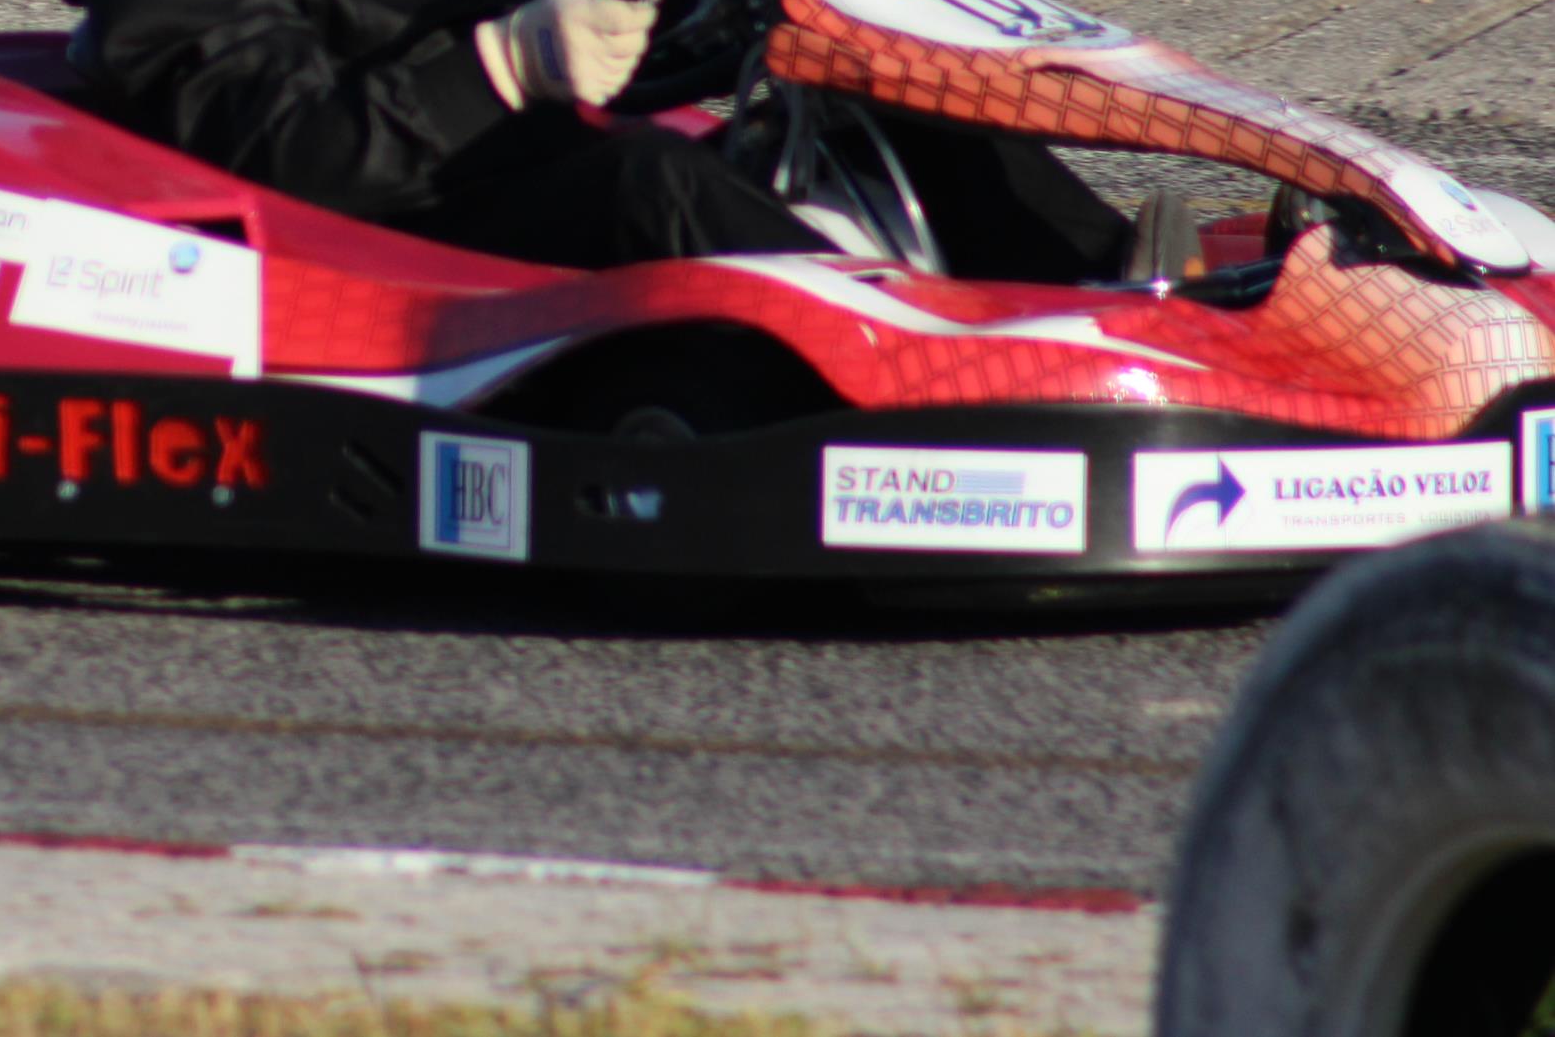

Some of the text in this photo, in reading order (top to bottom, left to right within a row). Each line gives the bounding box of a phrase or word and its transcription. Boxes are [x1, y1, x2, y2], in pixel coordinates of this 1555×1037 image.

[836, 465, 956, 494] STAND
[1273, 469, 1492, 505] LIGAÇÃO VELOZ
[834, 495, 1074, 529] TRANSBRITO
